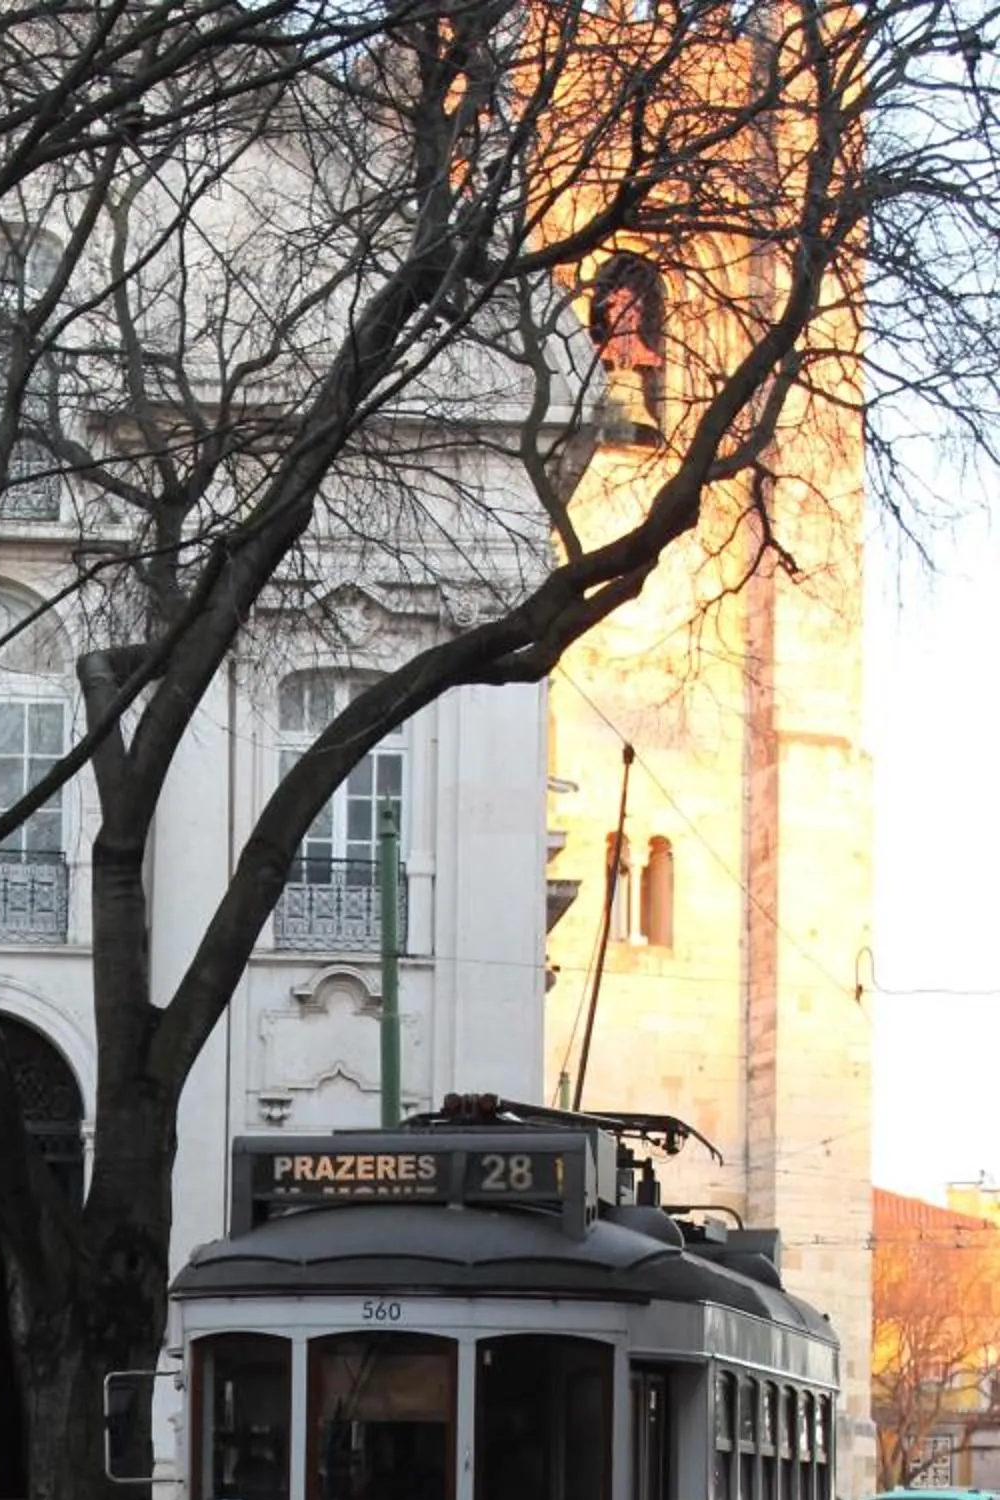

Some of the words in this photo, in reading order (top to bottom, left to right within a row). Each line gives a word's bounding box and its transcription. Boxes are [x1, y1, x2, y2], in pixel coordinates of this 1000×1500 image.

[274, 1154, 438, 1181] PRAZERES
[481, 1154, 533, 1191] 28
[362, 1301, 401, 1320] 560
